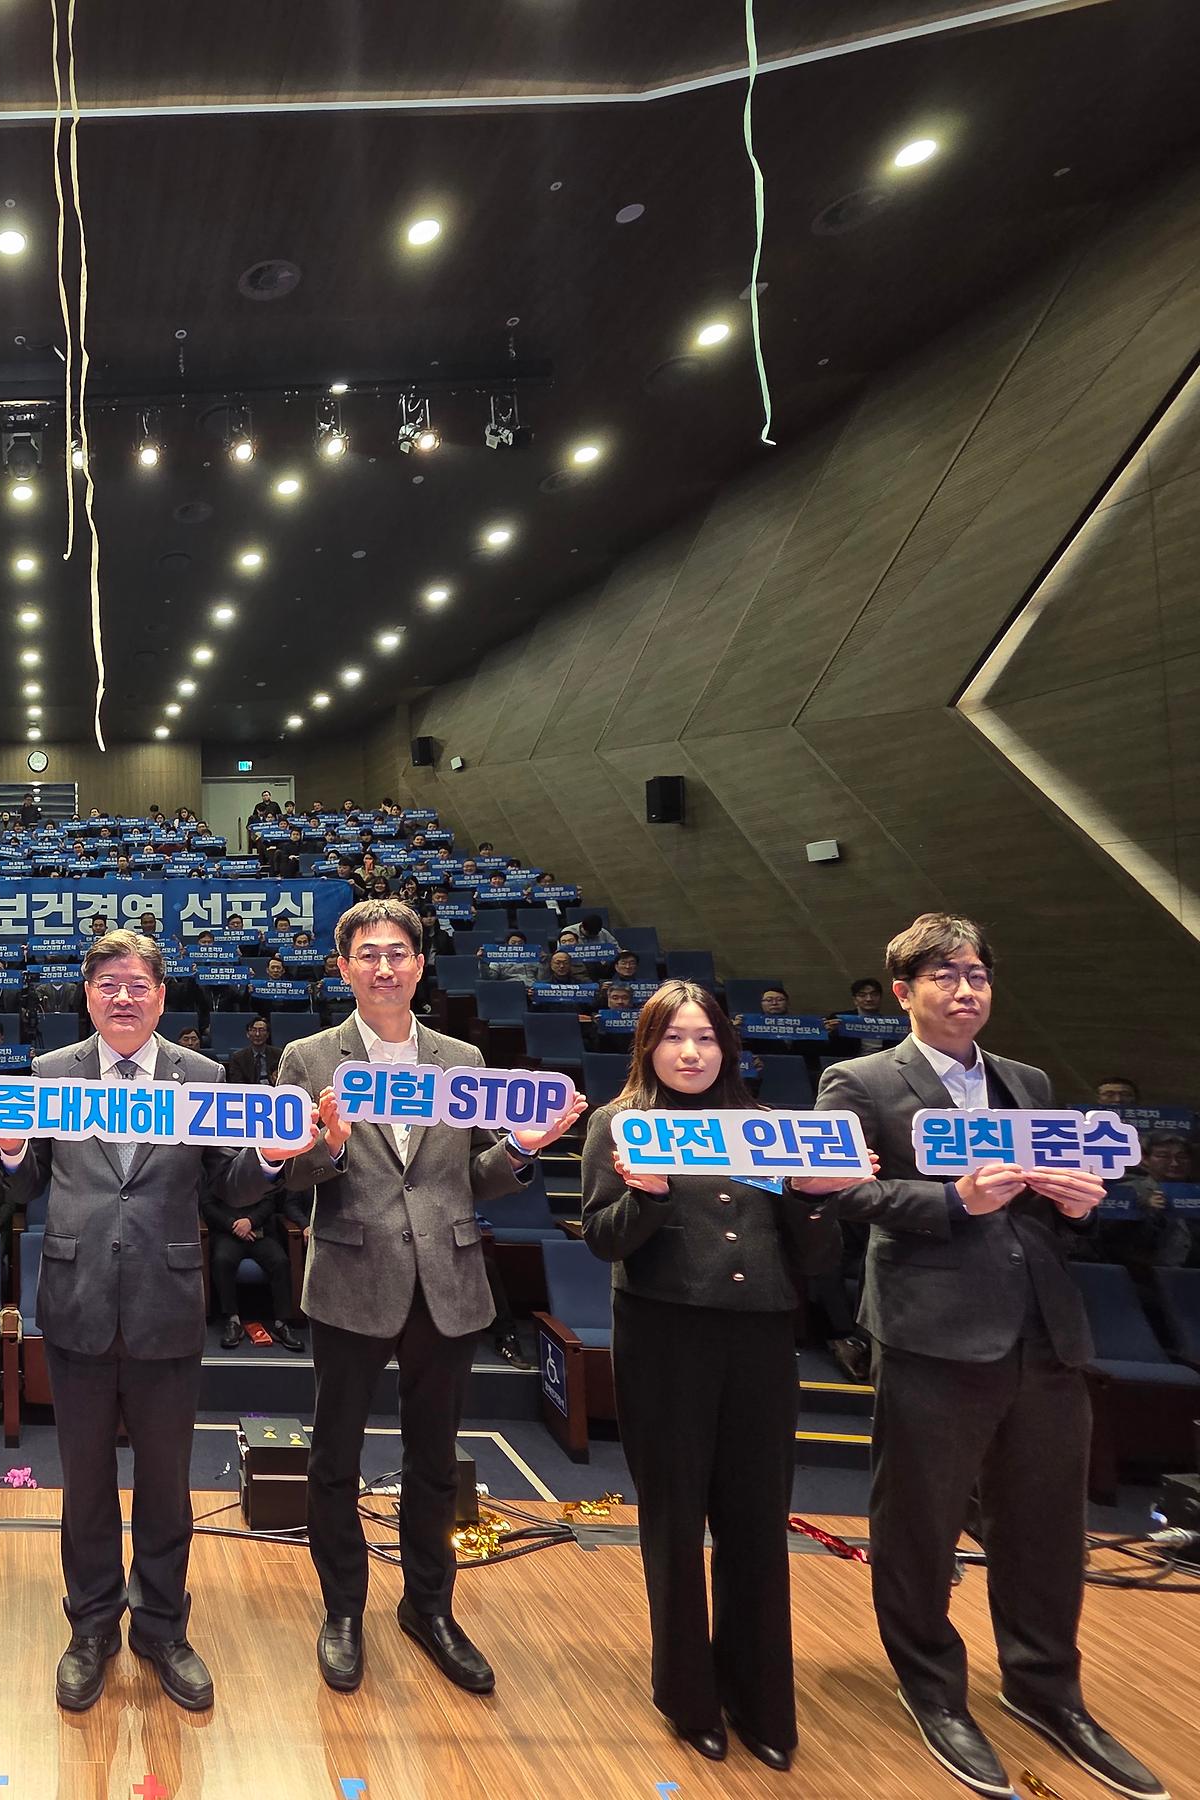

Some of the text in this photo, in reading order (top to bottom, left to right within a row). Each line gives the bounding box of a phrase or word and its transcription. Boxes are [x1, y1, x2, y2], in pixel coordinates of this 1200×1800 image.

[179, 891, 315, 937] 선포식
[188, 1090, 304, 1140] ZERO
[340, 1069, 567, 1124] 위험 STOP
[622, 1117, 861, 1168] 안전 인권
[923, 1118, 1131, 1169] 원칙 준수
